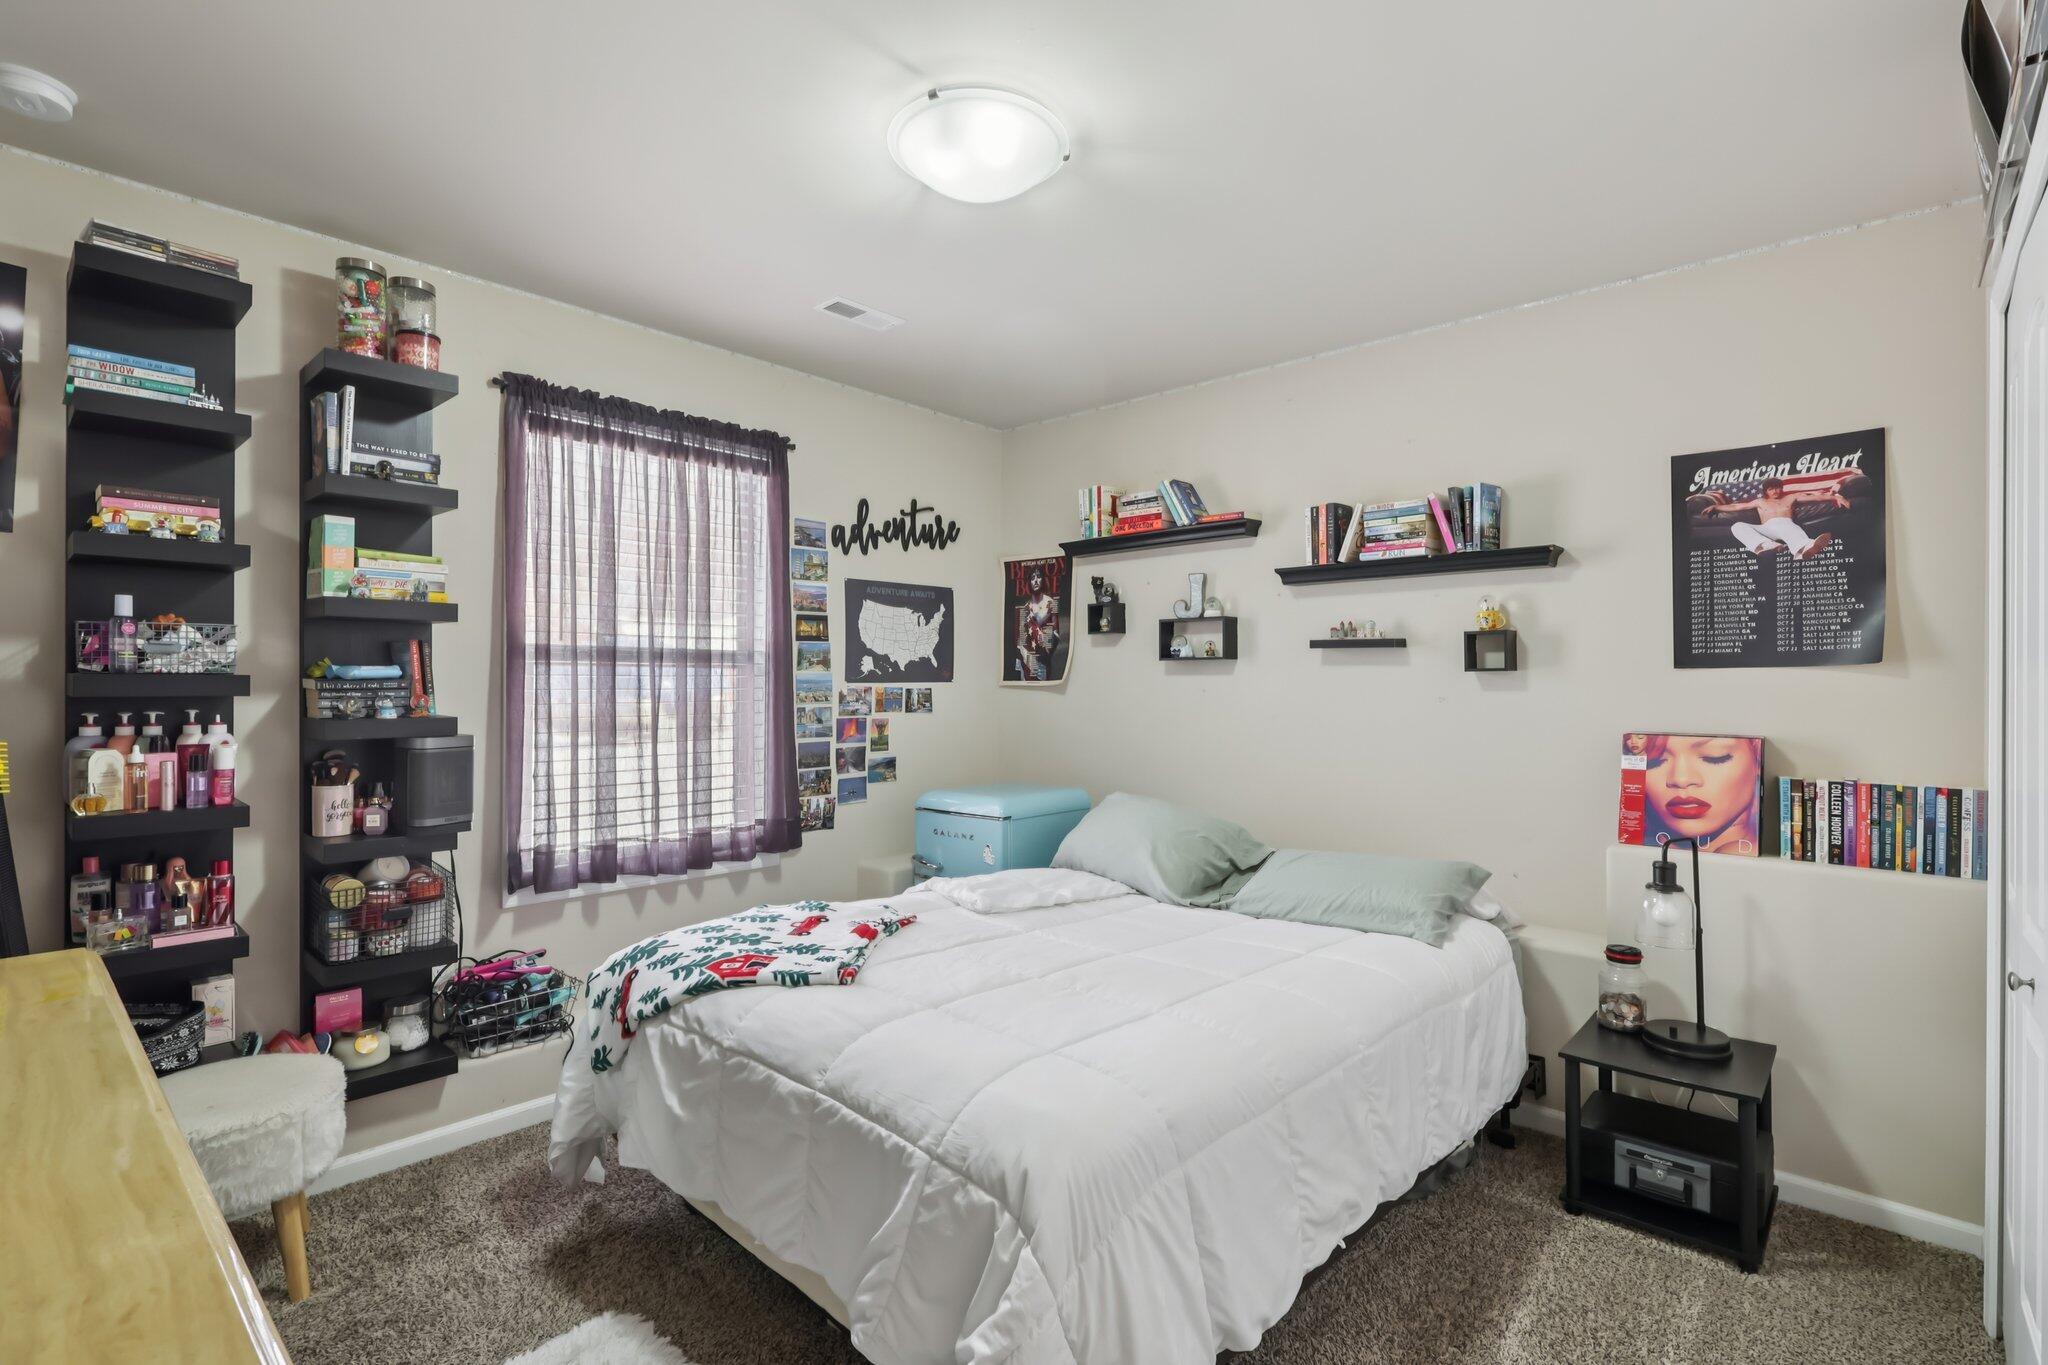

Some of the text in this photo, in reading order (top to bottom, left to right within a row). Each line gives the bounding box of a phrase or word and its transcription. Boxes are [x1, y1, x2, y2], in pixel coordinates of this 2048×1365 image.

[99, 363, 134, 375] WIDOW
[104, 385, 140, 394] ROBERTS
[1690, 448, 1863, 492] American Heart
[134, 502, 167, 511] SUMMER
[832, 498, 960, 555] adventure
[1127, 521, 1154, 530] DIRECTION
[866, 586, 936, 599] ADVENTURE AWAITS
[330, 799, 350, 810] hello
[326, 811, 352, 822] gorgeo
[1831, 784, 1841, 845] COLLEEN HOOVER
[1963, 797, 1971, 832] CONFESS
[933, 828, 974, 840] GALANZ
